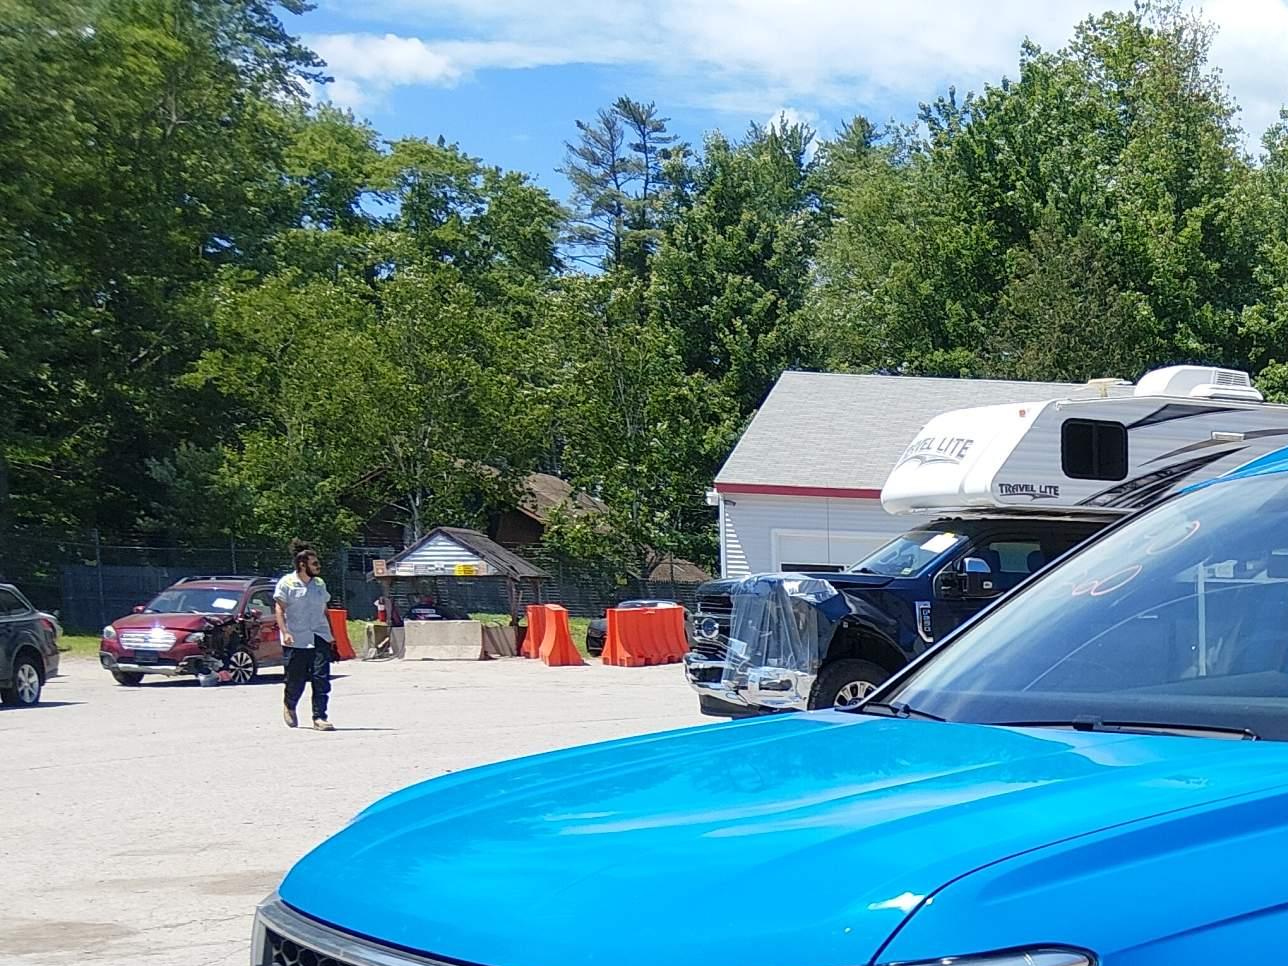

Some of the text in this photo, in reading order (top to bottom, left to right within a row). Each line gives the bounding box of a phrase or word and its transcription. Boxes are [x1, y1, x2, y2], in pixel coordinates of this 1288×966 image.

[936, 437, 974, 458] LITE
[999, 483, 1060, 496] TRAVEL LITE
